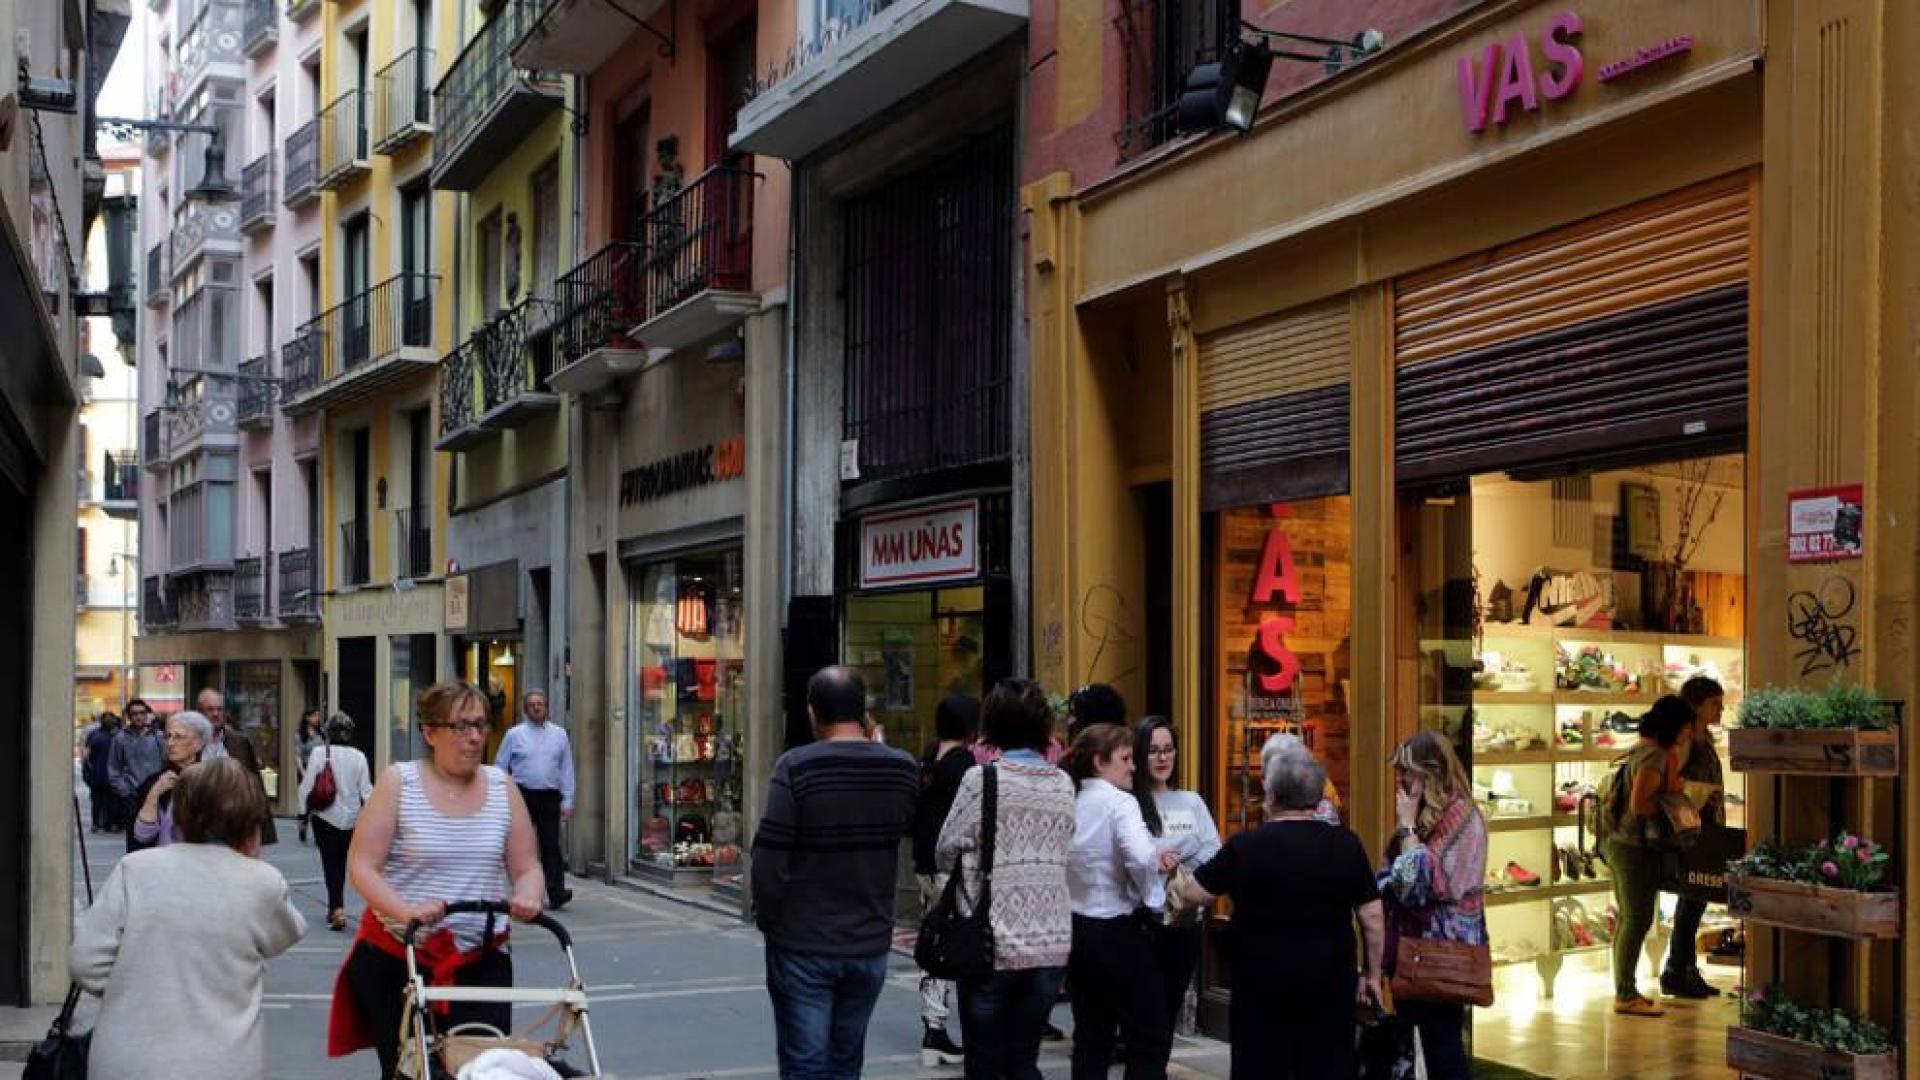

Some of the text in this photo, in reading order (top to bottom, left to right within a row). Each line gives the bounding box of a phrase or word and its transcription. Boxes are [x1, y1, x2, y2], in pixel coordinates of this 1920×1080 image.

[1458, 10, 1583, 133] VAS
[872, 520, 963, 567] MM UÑAS
[1251, 502, 1303, 692] AS
